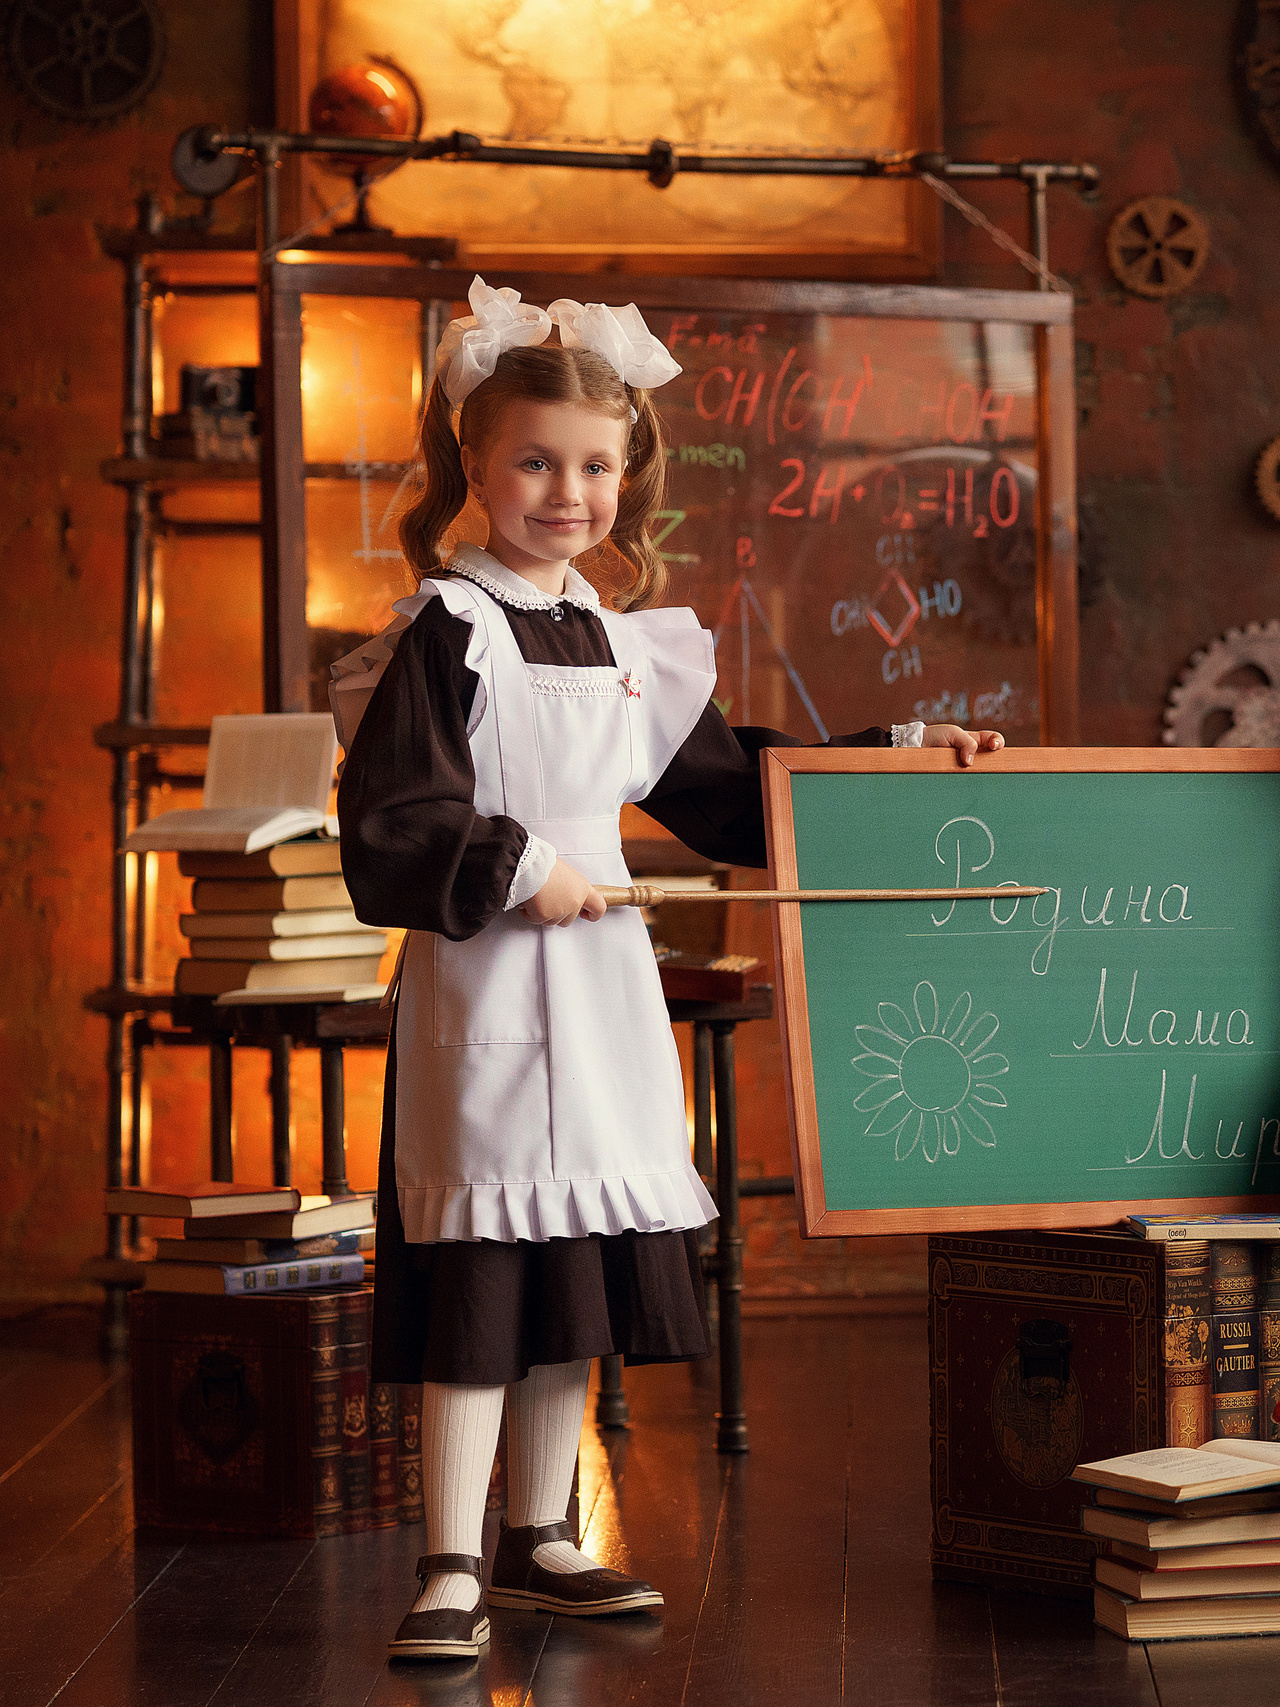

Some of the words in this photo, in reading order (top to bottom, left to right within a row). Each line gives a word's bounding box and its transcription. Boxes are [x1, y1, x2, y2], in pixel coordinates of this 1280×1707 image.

[930, 814, 1194, 976] Родина
[1072, 967, 1255, 1050] Мама
[1219, 1321, 1252, 1340] RUSSIA
[1216, 1354, 1256, 1373] GAUTIER
